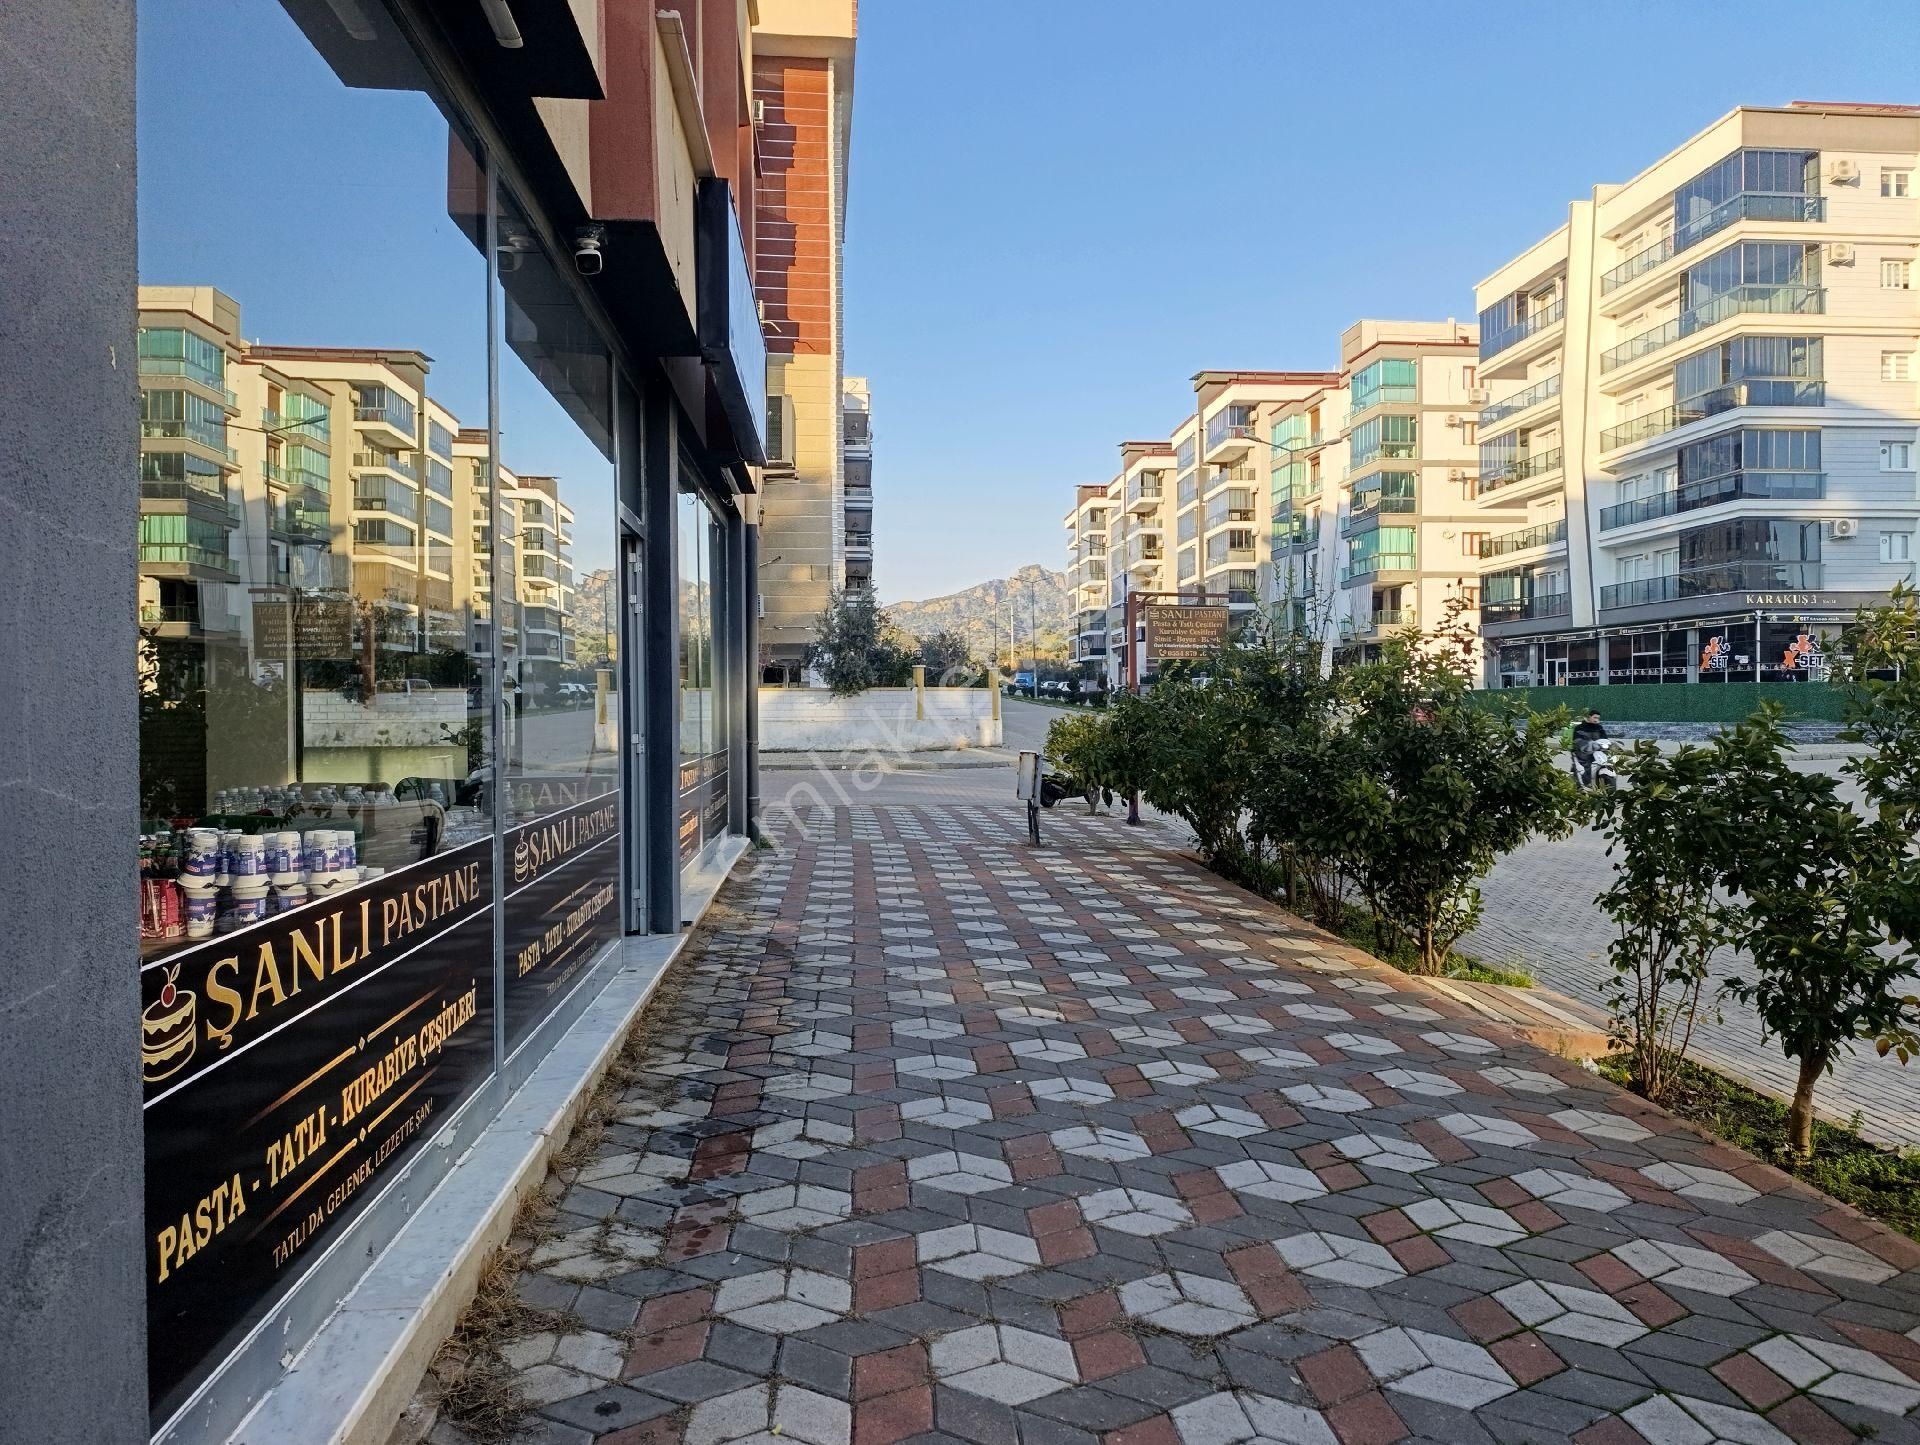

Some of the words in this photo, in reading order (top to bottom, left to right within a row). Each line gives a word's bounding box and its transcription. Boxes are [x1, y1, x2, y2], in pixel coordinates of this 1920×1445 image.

[1162, 610, 1192, 619] ŞANLI
[1195, 610, 1226, 619] PASTANE
[1746, 594, 1808, 606] KARAKUŞ
[1811, 594, 1817, 604] 3
[530, 816, 576, 876] ŞANLI
[579, 804, 615, 844] PASTANE
[206, 898, 372, 1050] ŞANLI
[382, 861, 480, 946] PASTANE
[518, 940, 540, 978] PASTA
[157, 1172, 246, 1284] PASTA
[266, 1105, 326, 1188] TATLI
[342, 1034, 417, 1126] KURABİYE
[420, 978, 476, 1066] ÇEŞİTLERİ
[272, 1220, 306, 1269] TATLI
[309, 1206, 324, 1236] DA
[327, 1156, 374, 1215] GELENEK,
[375, 1116, 414, 1166] LEZZETTE
[415, 1097, 433, 1130] ŞAN!
